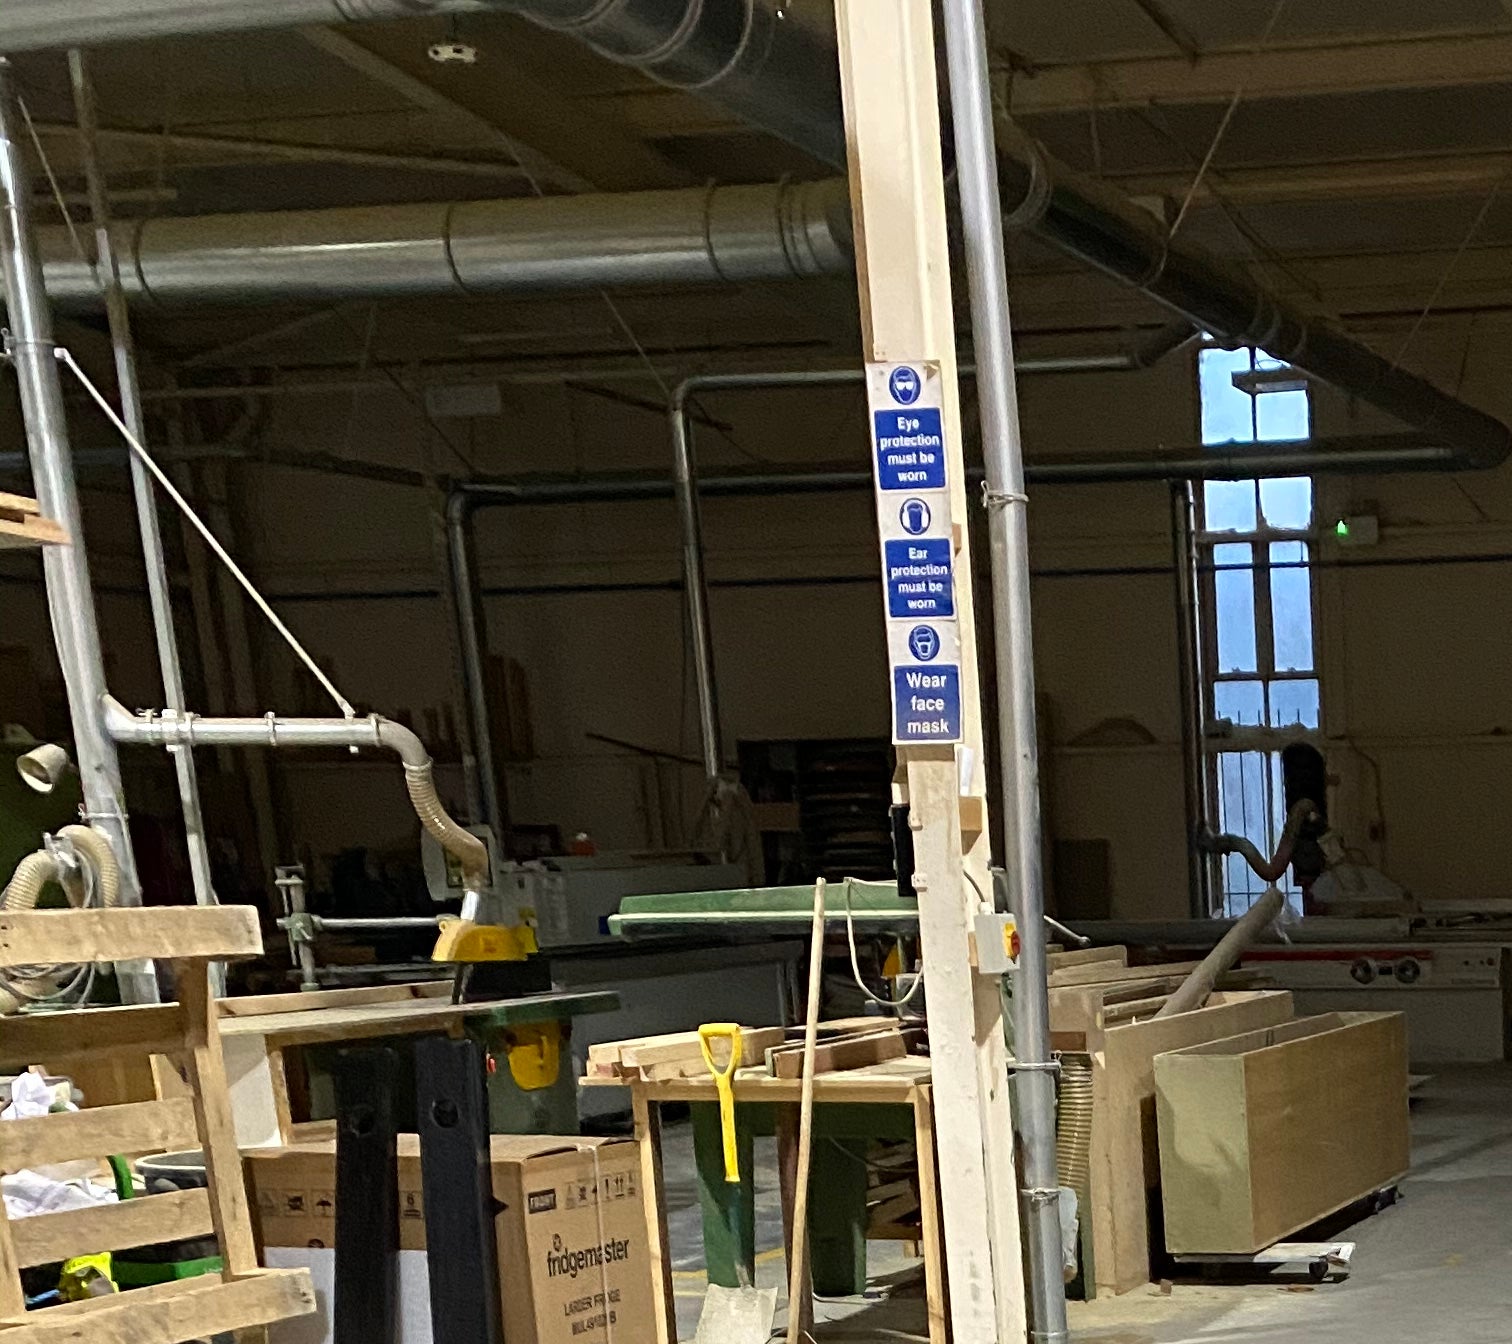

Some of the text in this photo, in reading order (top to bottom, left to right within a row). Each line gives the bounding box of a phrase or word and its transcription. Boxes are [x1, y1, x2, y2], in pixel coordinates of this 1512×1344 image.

[897, 416, 919, 432] Eye
[880, 433, 940, 451] protection
[887, 451, 935, 465] must be
[897, 471, 928, 482] worn
[908, 547, 928, 560] Ear
[891, 564, 948, 579] protection
[898, 580, 943, 593] must be
[907, 599, 936, 609] worn
[906, 672, 947, 688] Wear
[911, 695, 945, 711] face
[907, 718, 949, 734] mask
[547, 1238, 629, 1278] fridgemaster
[594, 1289, 621, 1307] FRDGE
